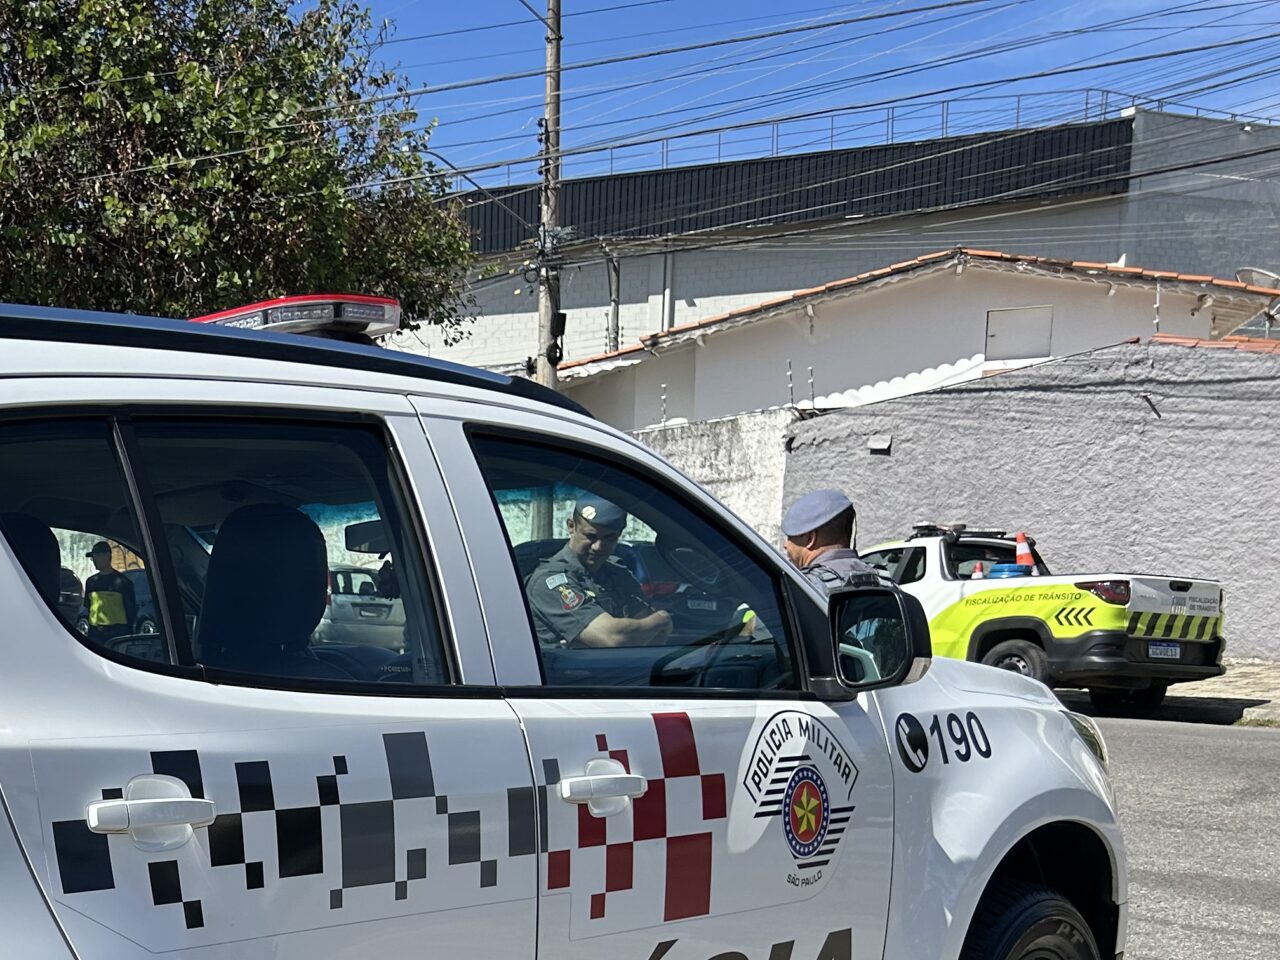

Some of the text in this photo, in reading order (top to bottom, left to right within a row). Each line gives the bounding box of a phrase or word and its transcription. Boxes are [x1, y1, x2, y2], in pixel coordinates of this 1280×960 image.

[965, 594, 1022, 607] FISCALIZAÇÃO
[1024, 594, 1035, 602] DE
[751, 717, 852, 794] POLÍCIA MILITAR
[929, 711, 993, 765] 190
[786, 870, 822, 887] SÃO PAULO
